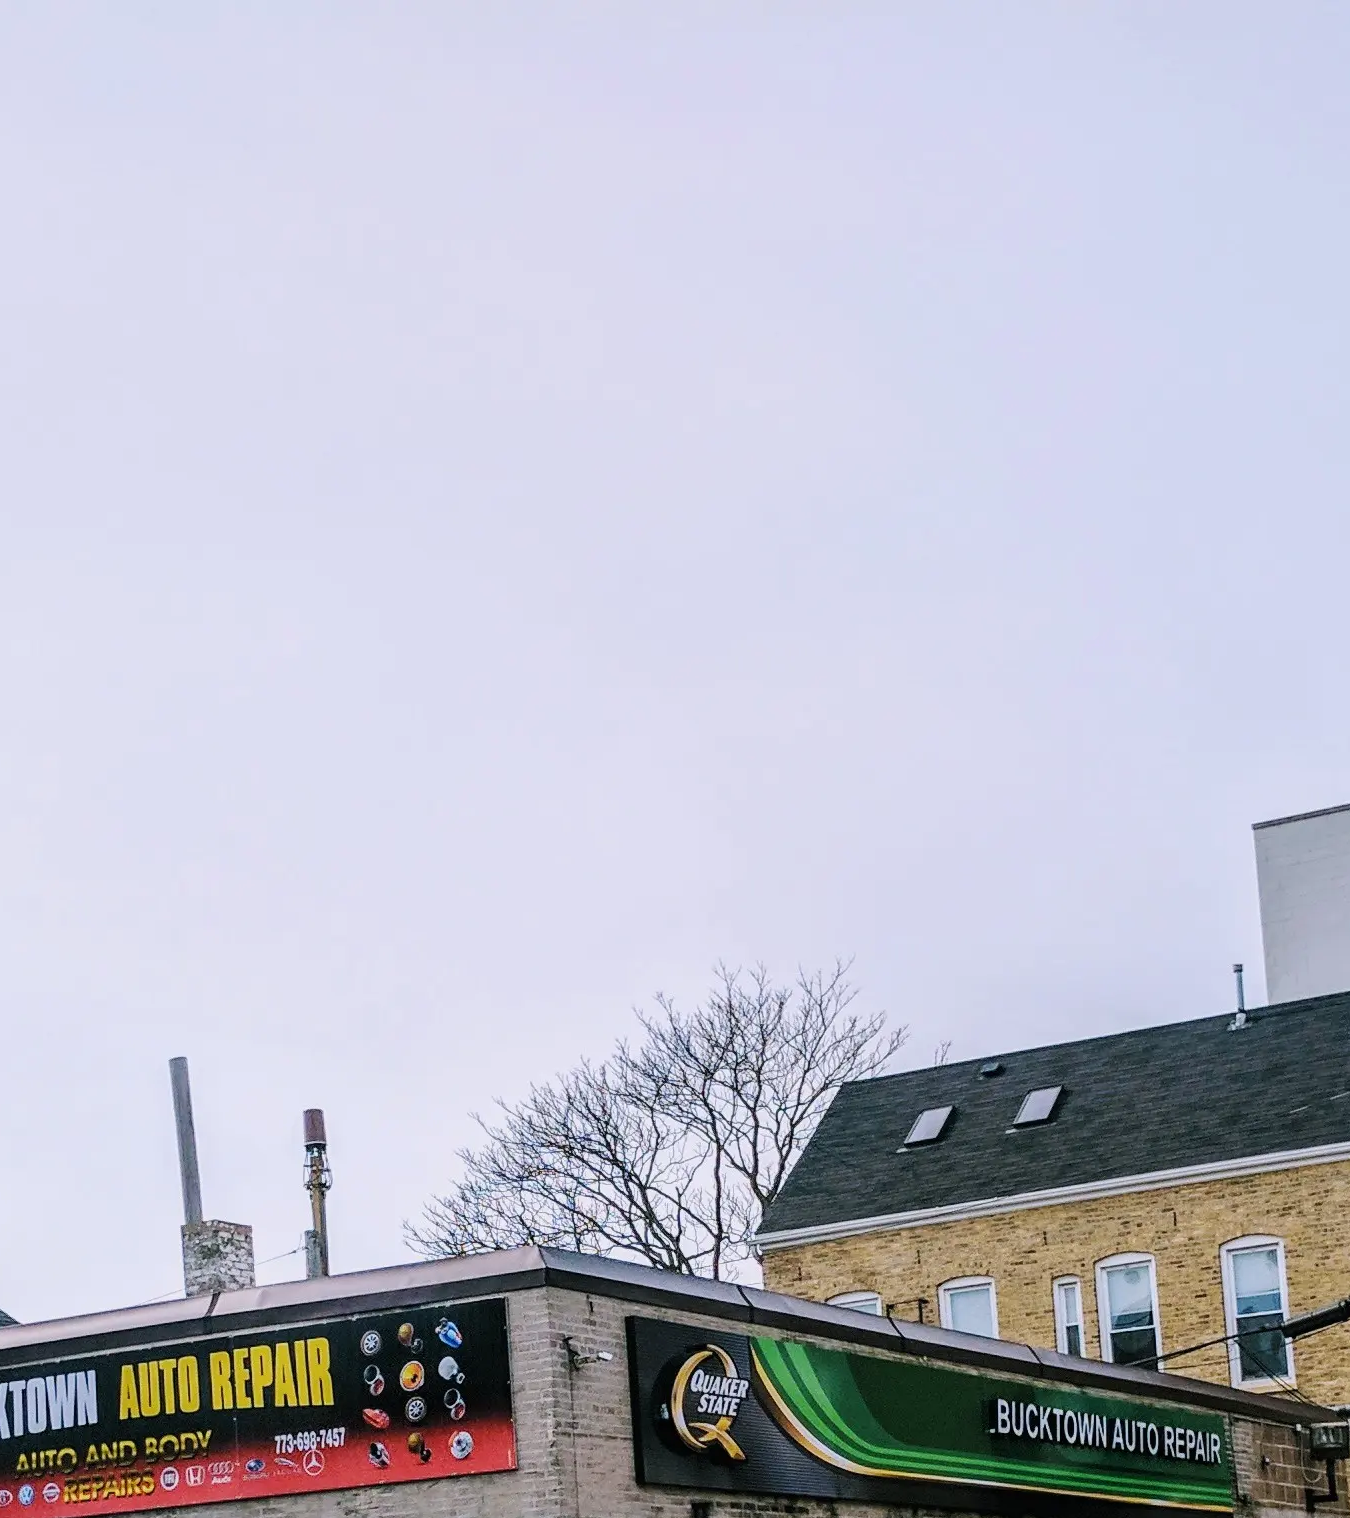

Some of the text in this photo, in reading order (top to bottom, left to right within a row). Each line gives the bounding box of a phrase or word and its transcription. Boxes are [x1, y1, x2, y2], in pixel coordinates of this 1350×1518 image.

[119, 1355, 200, 1420] AUTO
[209, 1337, 335, 1411] REPAIR
[691, 1369, 749, 1398] QUAKER
[697, 1394, 740, 1416] STATE
[274, 1427, 346, 1454] 773-698-7457
[997, 1398, 1222, 1464] BUCKTOWN AUTO REPAIR
[15, 1429, 212, 1478] AUTO AND BODY
[62, 1468, 156, 1503] REPAIRS
